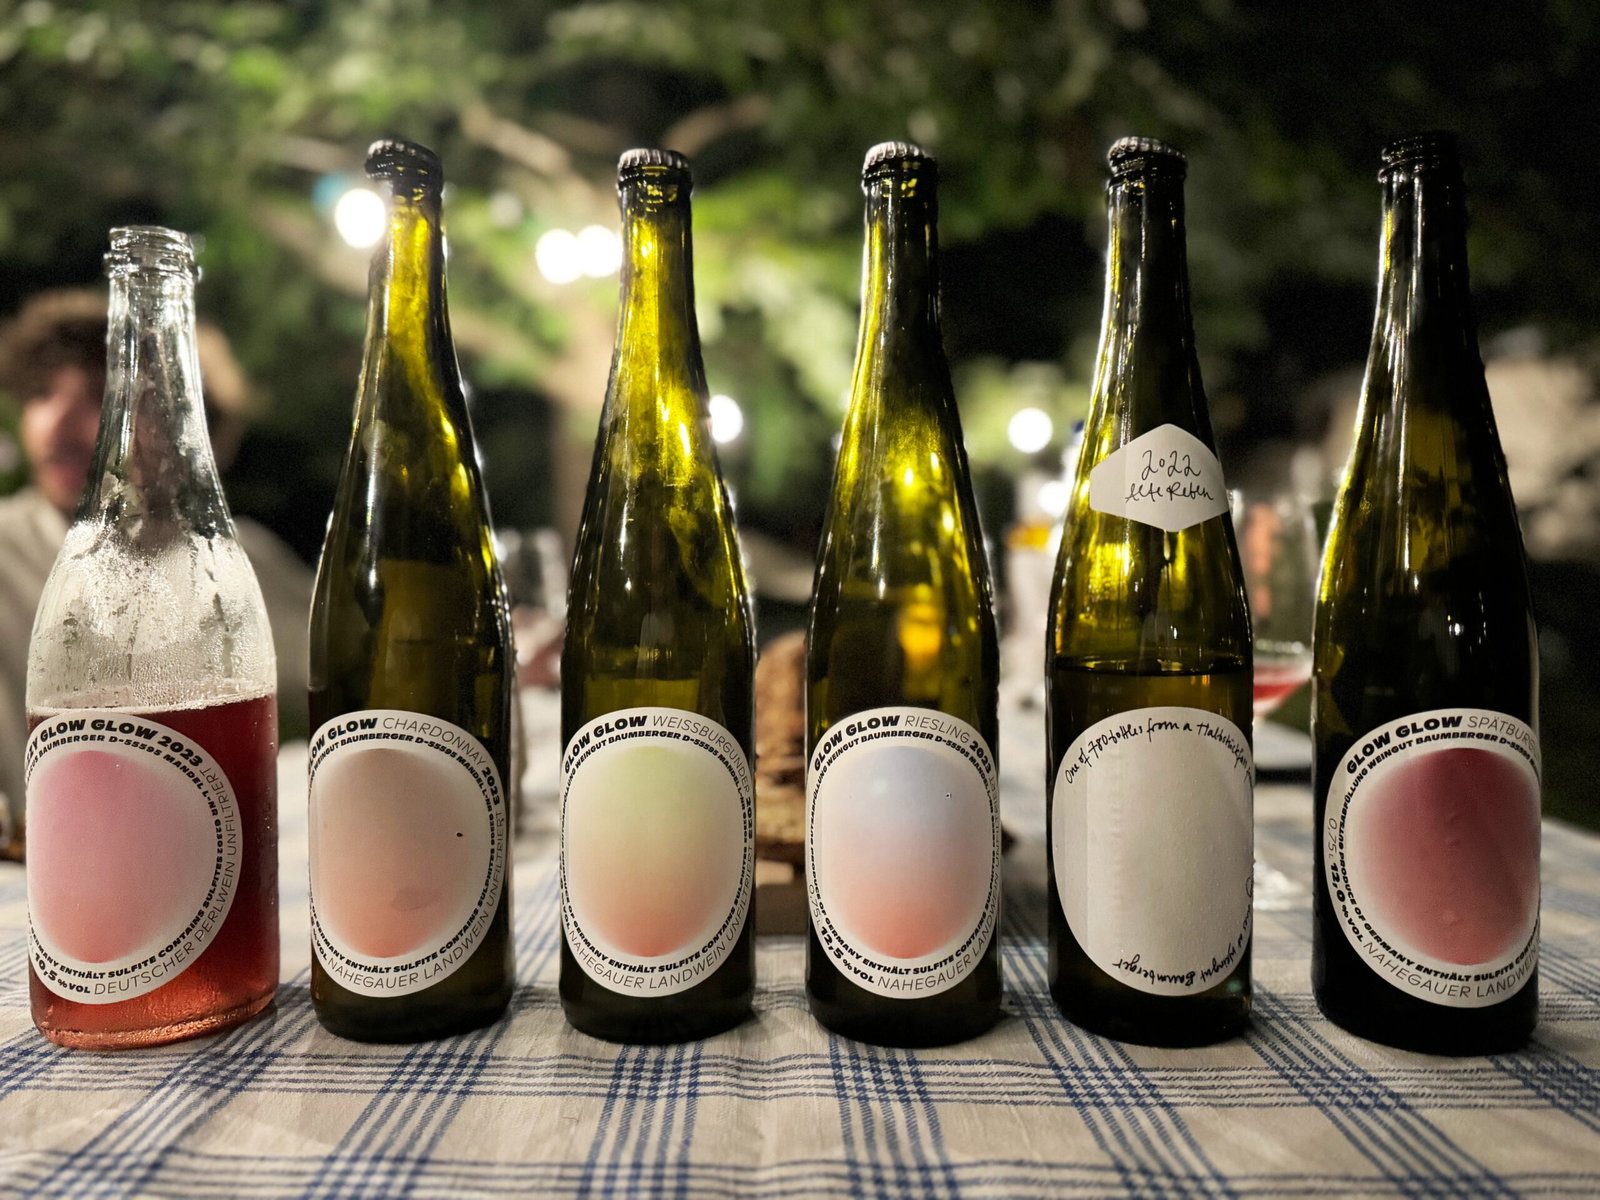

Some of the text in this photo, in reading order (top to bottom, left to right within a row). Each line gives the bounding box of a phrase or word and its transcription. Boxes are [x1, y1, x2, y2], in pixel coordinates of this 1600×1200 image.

[1142, 450, 1201, 480] 2022
[1166, 482, 1214, 501] Reben
[39, 735, 105, 755] BAUMBERGER
[108, 736, 161, 756] D-55595
[163, 754, 204, 790] MANDEL
[202, 790, 218, 815] L-NR
[40, 719, 86, 742] GLOW
[91, 719, 159, 740] GLOW
[157, 735, 203, 767] 2023
[314, 742, 340, 771] WEINGUT
[340, 733, 413, 746] BAUMBERGER
[415, 736, 456, 758] D-55595
[456, 756, 485, 789] MANDEL
[328, 718, 378, 740] GLOW
[383, 717, 486, 765] CHARDONNAY
[481, 767, 499, 806] 2023
[575, 740, 607, 768] WEINGUT
[608, 730, 681, 744] BAUMBERGER
[682, 734, 718, 757] D-55595
[718, 753, 740, 788] MANDEL
[814, 715, 991, 774] GLOW GLOW RIESLING 2023
[827, 738, 859, 767] WEINGUT
[861, 730, 934, 743] BAUMBERGER
[934, 735, 969, 758] D-55595
[968, 756, 990, 790] MANDEL
[1065, 764, 1080, 784] One
[1078, 748, 1093, 767] of
[1108, 724, 1143, 744] bottles
[1146, 718, 1180, 742] from
[1183, 723, 1193, 732] a
[1346, 732, 1391, 774] GLOW
[1396, 716, 1463, 739] GLOW
[564, 715, 753, 840] GLOW GLOW WEISSBURGUNDER 2023
[1338, 768, 1368, 849] GUTSABFÜLLUNG
[1368, 739, 1414, 769] WEINGUT
[1415, 732, 1498, 745] BAUMBERGER
[199, 767, 237, 857] UNFILTRIERT
[60, 963, 106, 979] ENTHÄLT
[108, 957, 157, 978] SULFITE
[158, 909, 205, 958] CONTAINS
[203, 854, 223, 908] SULFITES
[194, 861, 235, 942] PERLWEIN
[328, 957, 419, 989] NAHEGAUER
[424, 910, 489, 980] LANDWEIN
[486, 812, 505, 907] UNFILTRIERT
[1331, 863, 1346, 903] 12,0
[1364, 942, 1471, 997] NAHEGAUER
[1339, 853, 1356, 905] PRODUCE
[1354, 906, 1366, 922] OF
[1364, 922, 1415, 966] GERMANY
[1415, 964, 1472, 982] ENTHÄLT
[1473, 964, 1514, 982] SULFITE
[35, 952, 58, 981] 10,5
[94, 942, 195, 995] DEUTSCHER
[316, 919, 345, 960] GERMANY
[345, 959, 391, 974] ENTHÄLT
[393, 952, 438, 973] SULFITE
[439, 910, 479, 954] CONTAINS
[568, 904, 576, 919] OF
[573, 920, 608, 961] GERMANY
[608, 960, 656, 973] ENTHÄLT
[658, 952, 700, 973] SULFITE
[702, 906, 735, 954] CONTAINS
[569, 930, 645, 989] NAHEGAUER
[650, 944, 726, 989] LANDWEIN
[819, 901, 827, 917] OF
[825, 917, 862, 960] GERMANY
[862, 958, 910, 975] ENTHÄLT
[912, 955, 954, 975] SULFITE
[955, 911, 987, 958] CONTAINS
[820, 926, 844, 959] 12,5
[877, 954, 972, 991] NAHEGAUER
[1112, 954, 1196, 987] Baumberger
